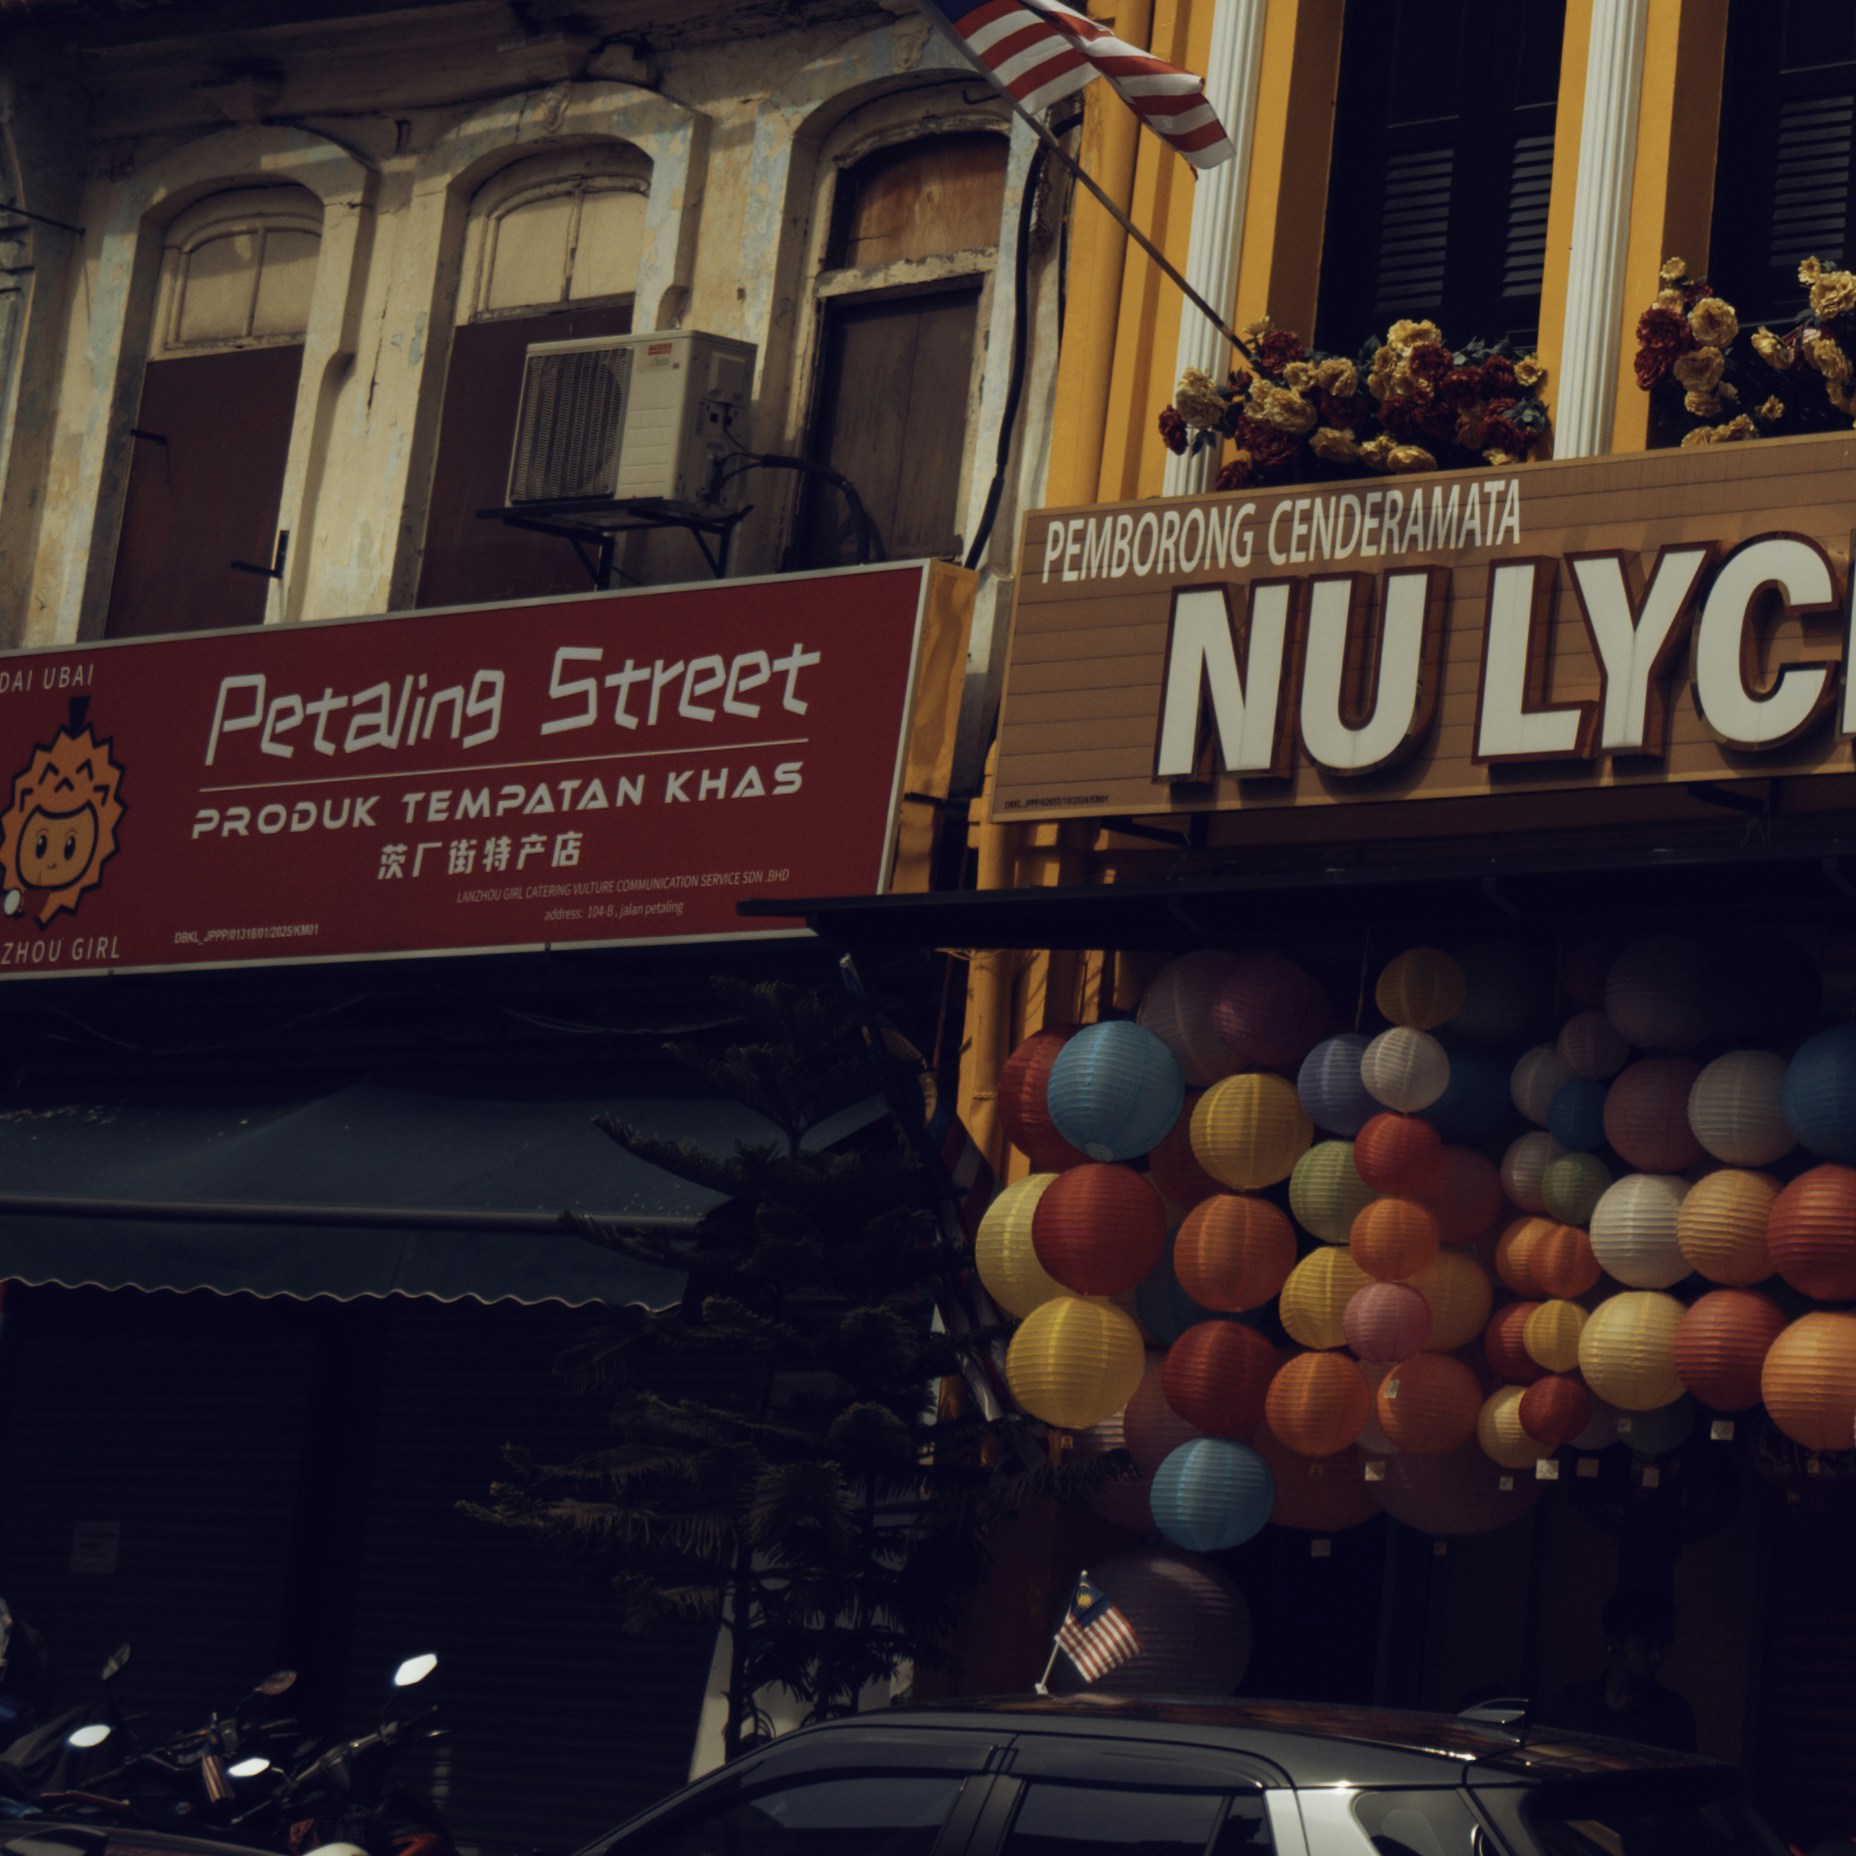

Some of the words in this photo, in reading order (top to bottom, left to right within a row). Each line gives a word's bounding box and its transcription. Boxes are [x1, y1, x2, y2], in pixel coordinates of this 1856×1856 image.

[1042, 501, 1256, 585] PEMBORONG
[1267, 479, 1521, 566] CENDERAMATA
[43, 664, 94, 690] UBAI
[1153, 565, 1445, 783] NU
[205, 668, 505, 766] Petaling
[540, 643, 821, 736] Street
[191, 795, 381, 840] PRODUK
[400, 774, 645, 824] TEMPATAN
[664, 760, 804, 804] KHAS
[377, 830, 584, 881] 茨厂街特产店
[456, 888, 501, 904] LANZHOU
[503, 886, 524, 901] GIRL
[525, 883, 573, 899] CATERING
[573, 879, 615, 896] VULTURE
[616, 874, 700, 893] COMMUNICATION
[700, 871, 740, 888] SERVICE
[644, 900, 685, 918] petaling
[1, 939, 61, 965] ZHOU
[72, 936, 120, 961] GIRL
